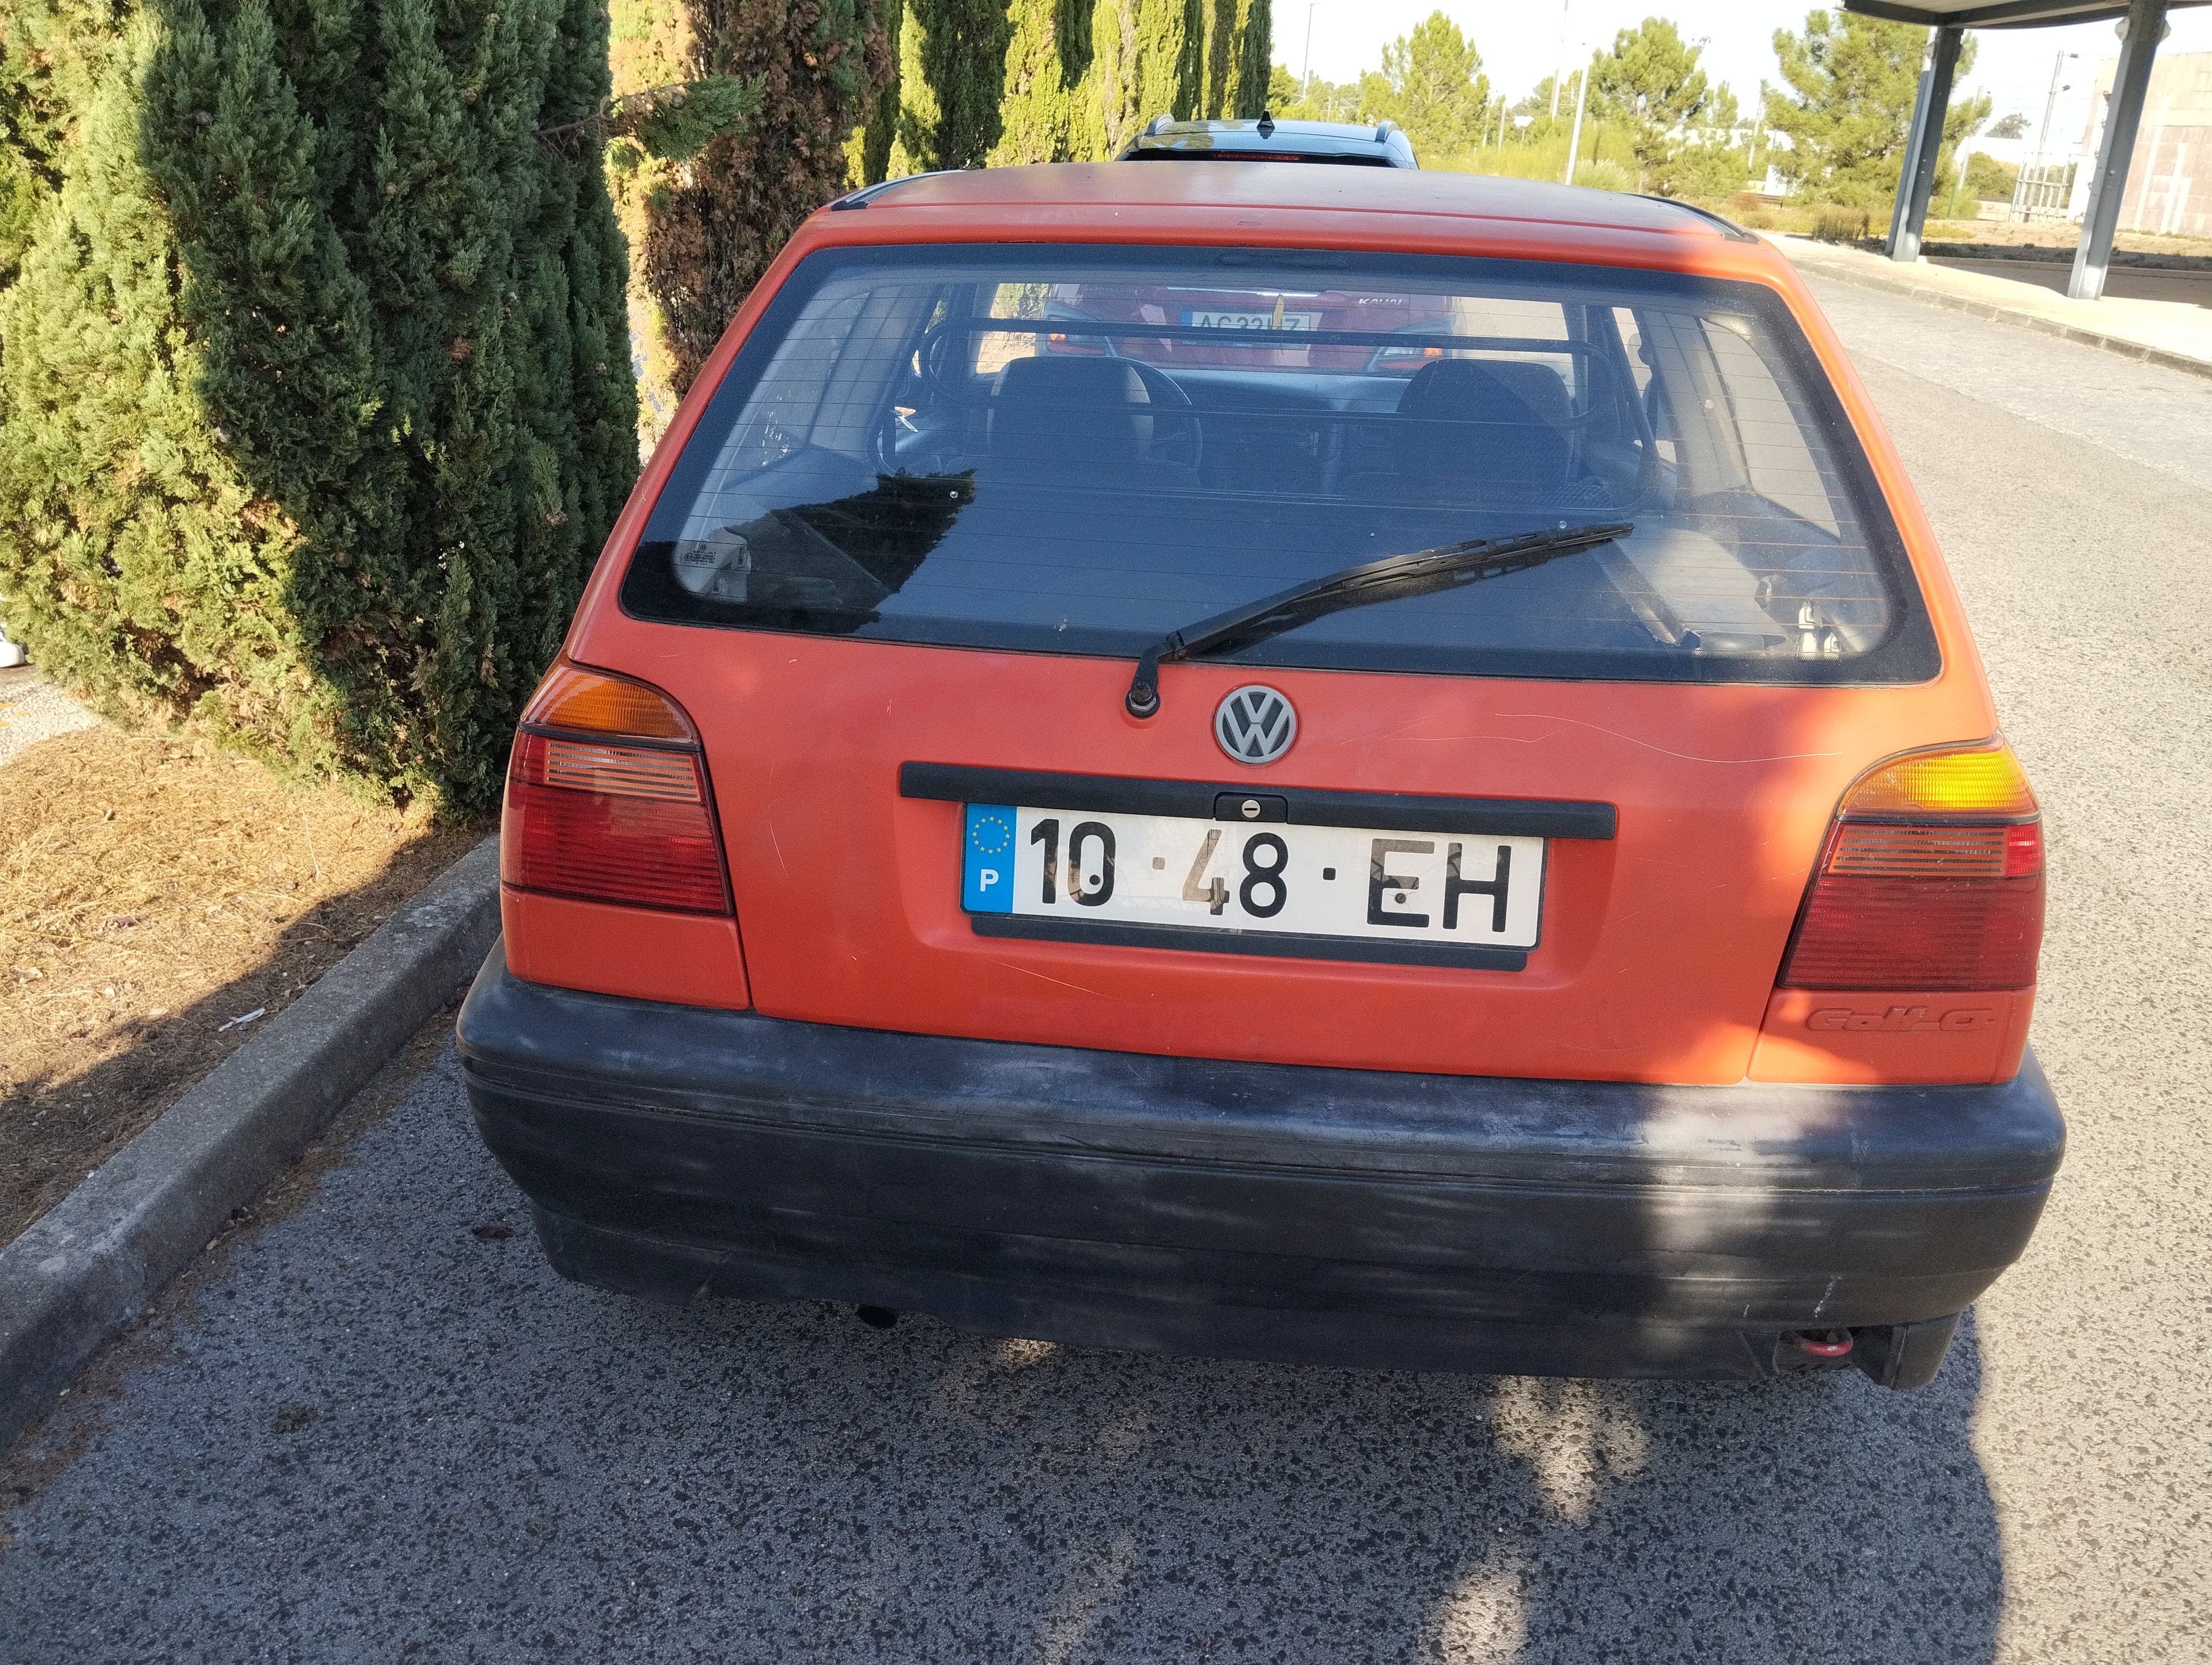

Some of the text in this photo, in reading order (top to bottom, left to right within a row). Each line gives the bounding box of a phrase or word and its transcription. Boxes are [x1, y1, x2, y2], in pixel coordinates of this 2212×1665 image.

[1214, 685, 1297, 764] VW
[979, 868, 999, 892] P
[1031, 818, 1512, 933] 10 48 EH
[1805, 1005, 1929, 1032] Golf
